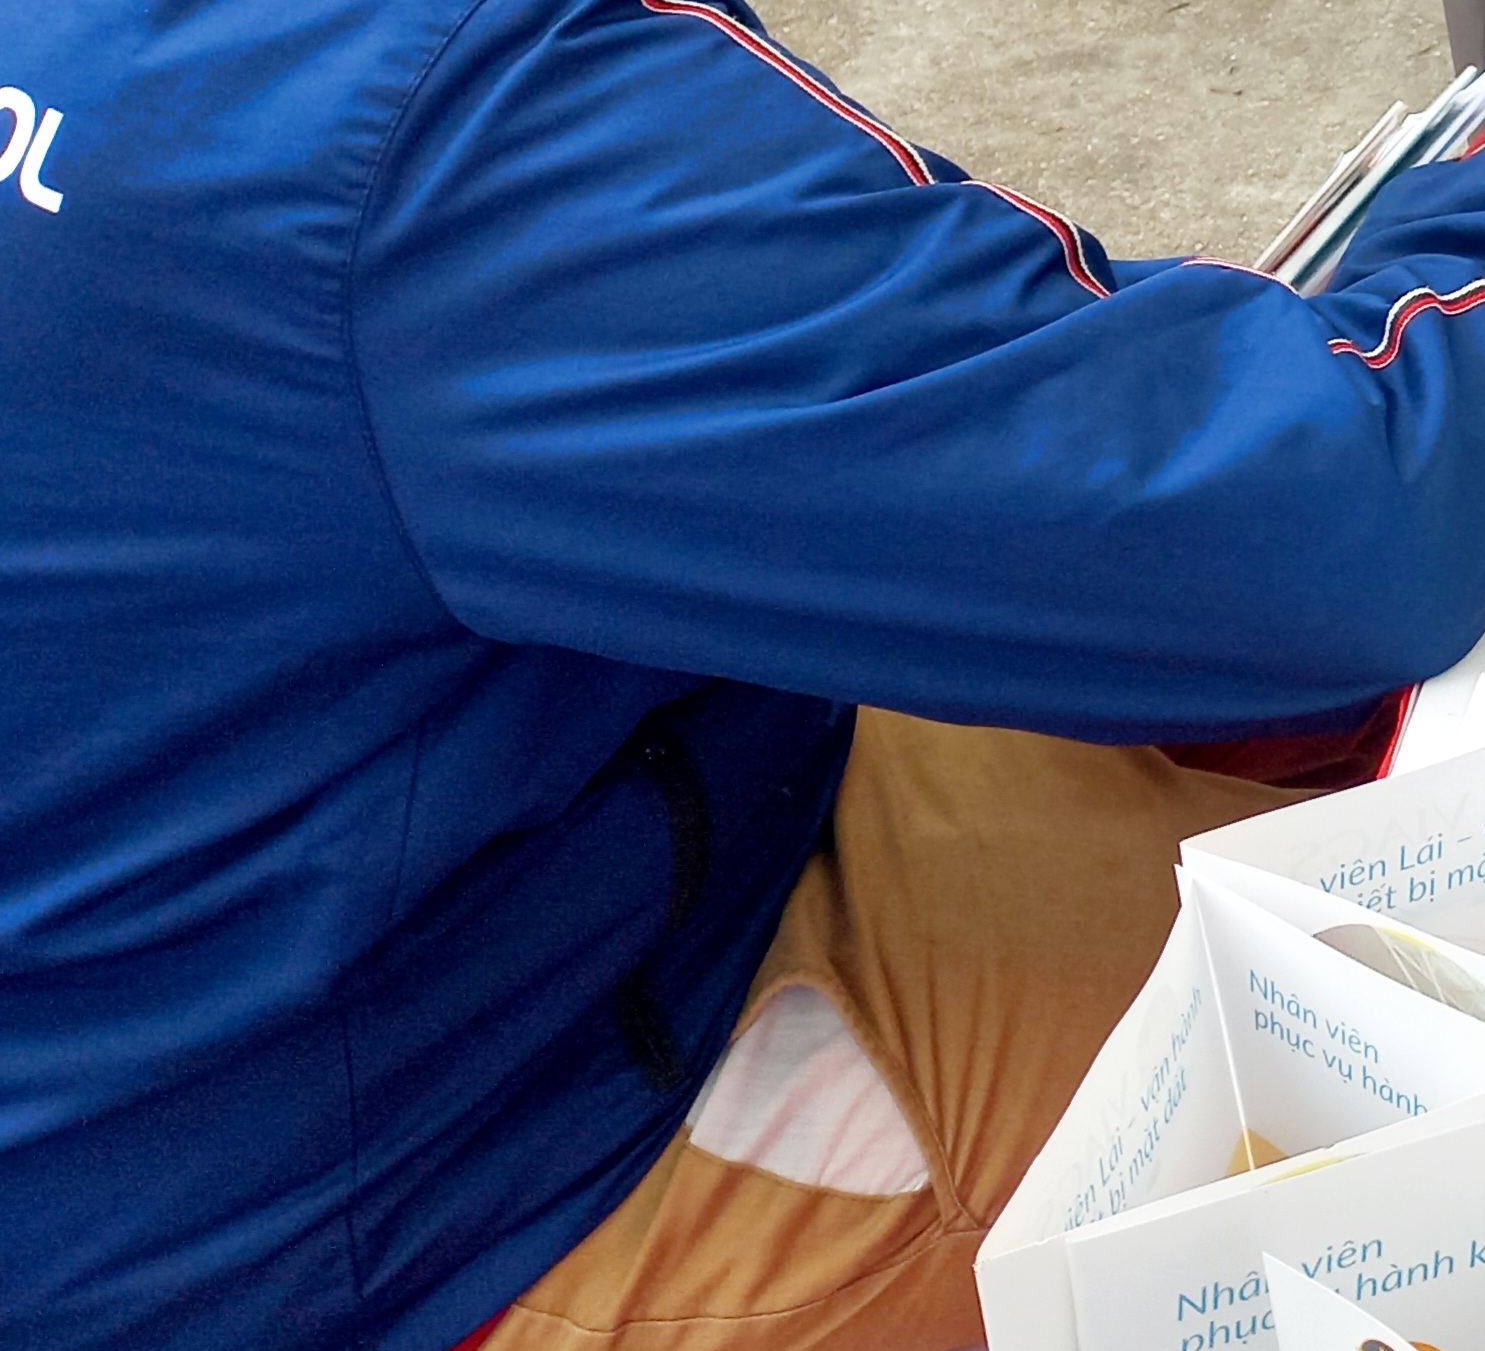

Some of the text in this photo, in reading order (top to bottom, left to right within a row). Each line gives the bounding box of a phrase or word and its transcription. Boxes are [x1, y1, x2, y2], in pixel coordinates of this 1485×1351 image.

[1320, 857, 1386, 894] viên
[1400, 833, 1443, 871] Lái
[1409, 870, 1436, 902] bị
[1250, 969, 1379, 1063] Nhân viên
[1255, 1009, 1428, 1116] phục vụ hành
[1177, 1237, 1385, 1322] Nhâ viên
[1356, 1249, 1455, 1302] hành
